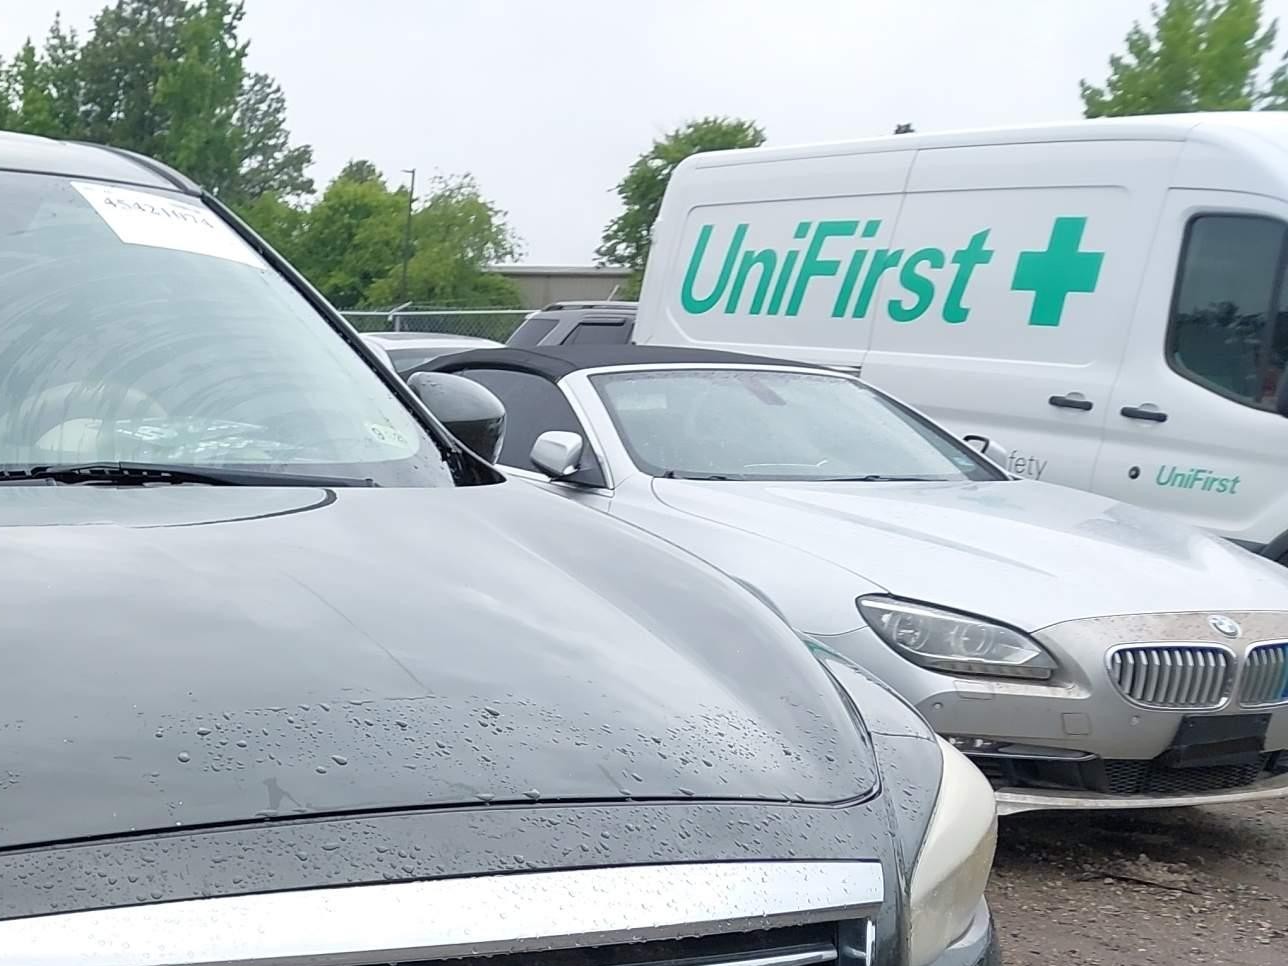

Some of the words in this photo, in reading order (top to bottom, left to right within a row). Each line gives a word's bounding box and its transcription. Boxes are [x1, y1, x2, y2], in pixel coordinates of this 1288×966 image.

[680, 219, 995, 324] UniFirst
[1006, 450, 1048, 480] fety
[1155, 465, 1242, 494] UniFirst
